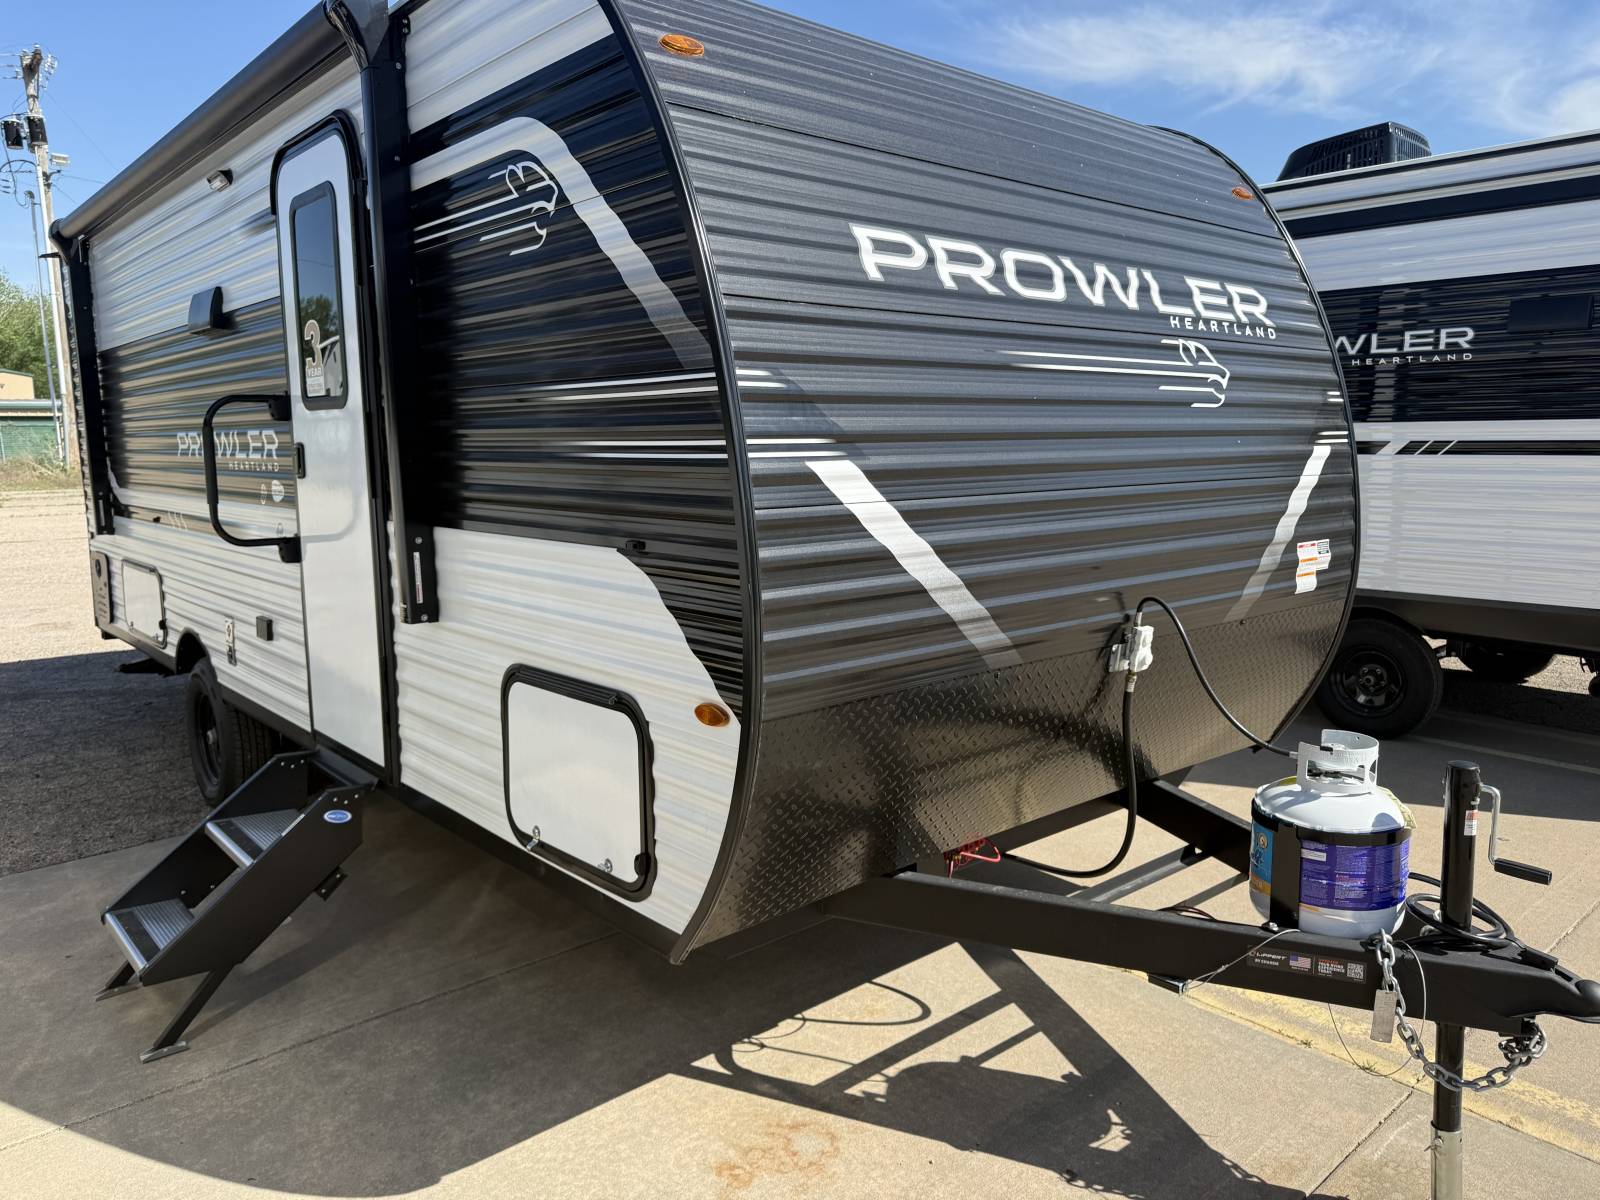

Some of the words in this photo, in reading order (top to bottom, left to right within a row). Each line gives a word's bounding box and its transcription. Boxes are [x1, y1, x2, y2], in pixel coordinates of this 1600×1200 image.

[849, 222, 1277, 328] PROWLER
[1170, 316, 1277, 340] HEARTLAND
[1335, 327, 1475, 355] WLER
[304, 319, 323, 368] 3
[1352, 353, 1473, 366] HEARTLAND
[177, 430, 279, 459] PRWLER
[229, 462, 280, 472] HEARTLAND
